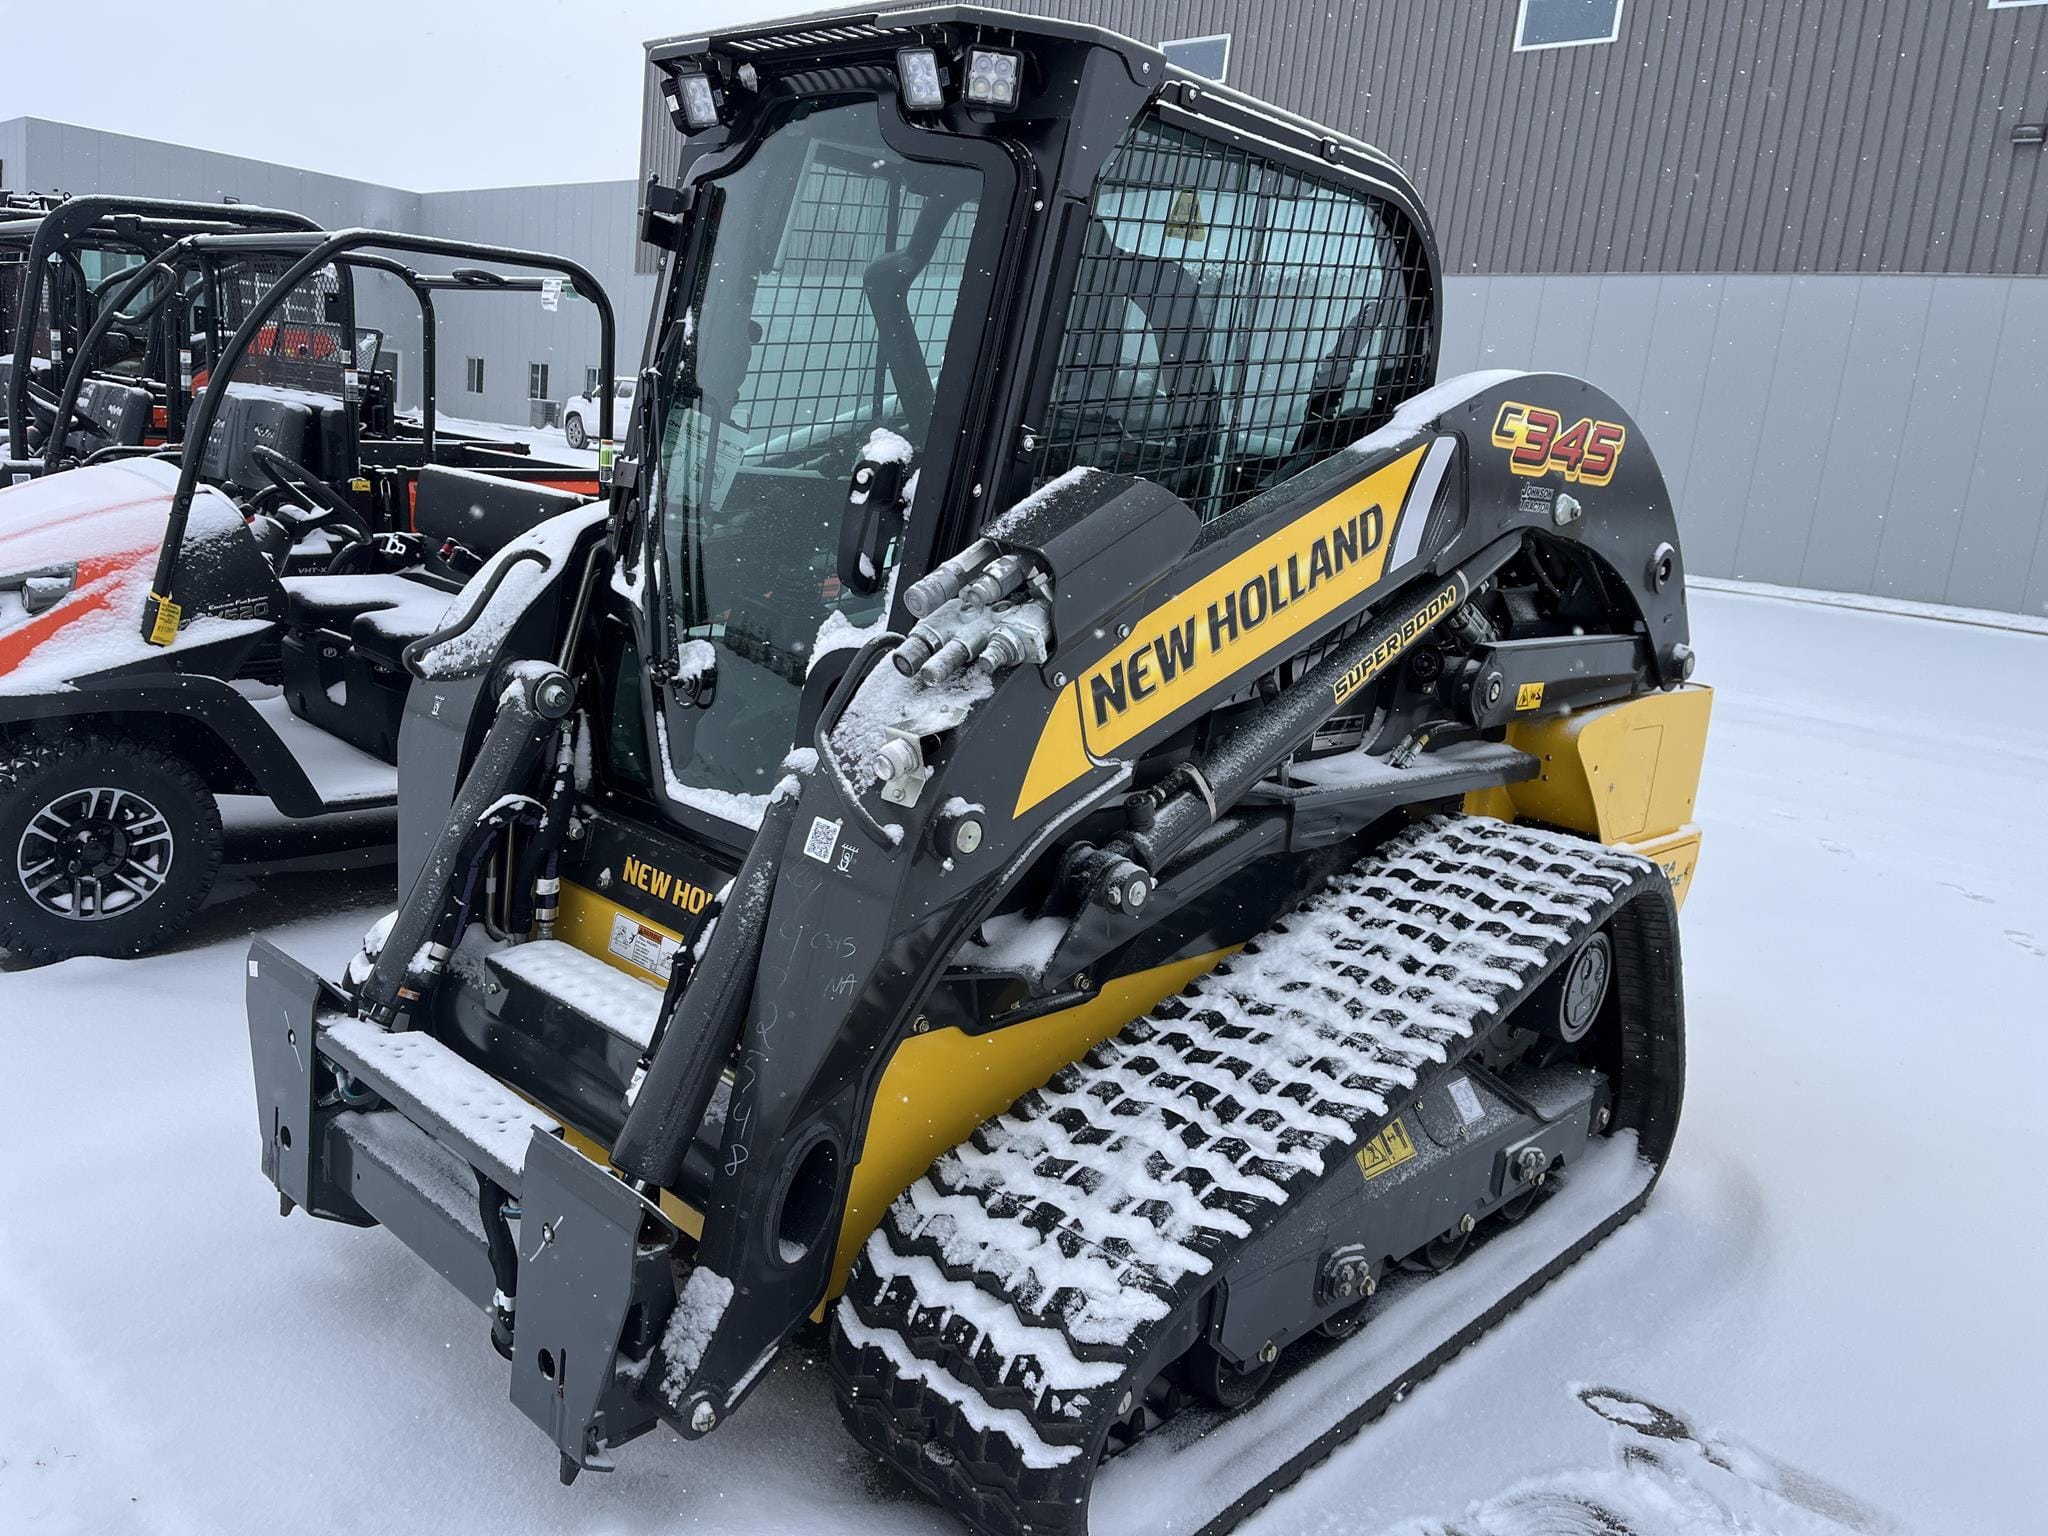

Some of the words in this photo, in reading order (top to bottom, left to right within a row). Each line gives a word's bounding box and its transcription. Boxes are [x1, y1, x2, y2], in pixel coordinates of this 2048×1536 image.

[1493, 403, 1625, 485] C345
[1519, 498, 1551, 514] TRACTOR
[1521, 482, 1554, 500] JOHNSON
[298, 566, 328, 575] VHT-X
[1090, 613, 1197, 730] NEW
[1206, 502, 1385, 655] HOLLAND
[1333, 632, 1402, 704] SUPER
[1400, 584, 1457, 647] BOOM
[622, 856, 672, 900] NEW
